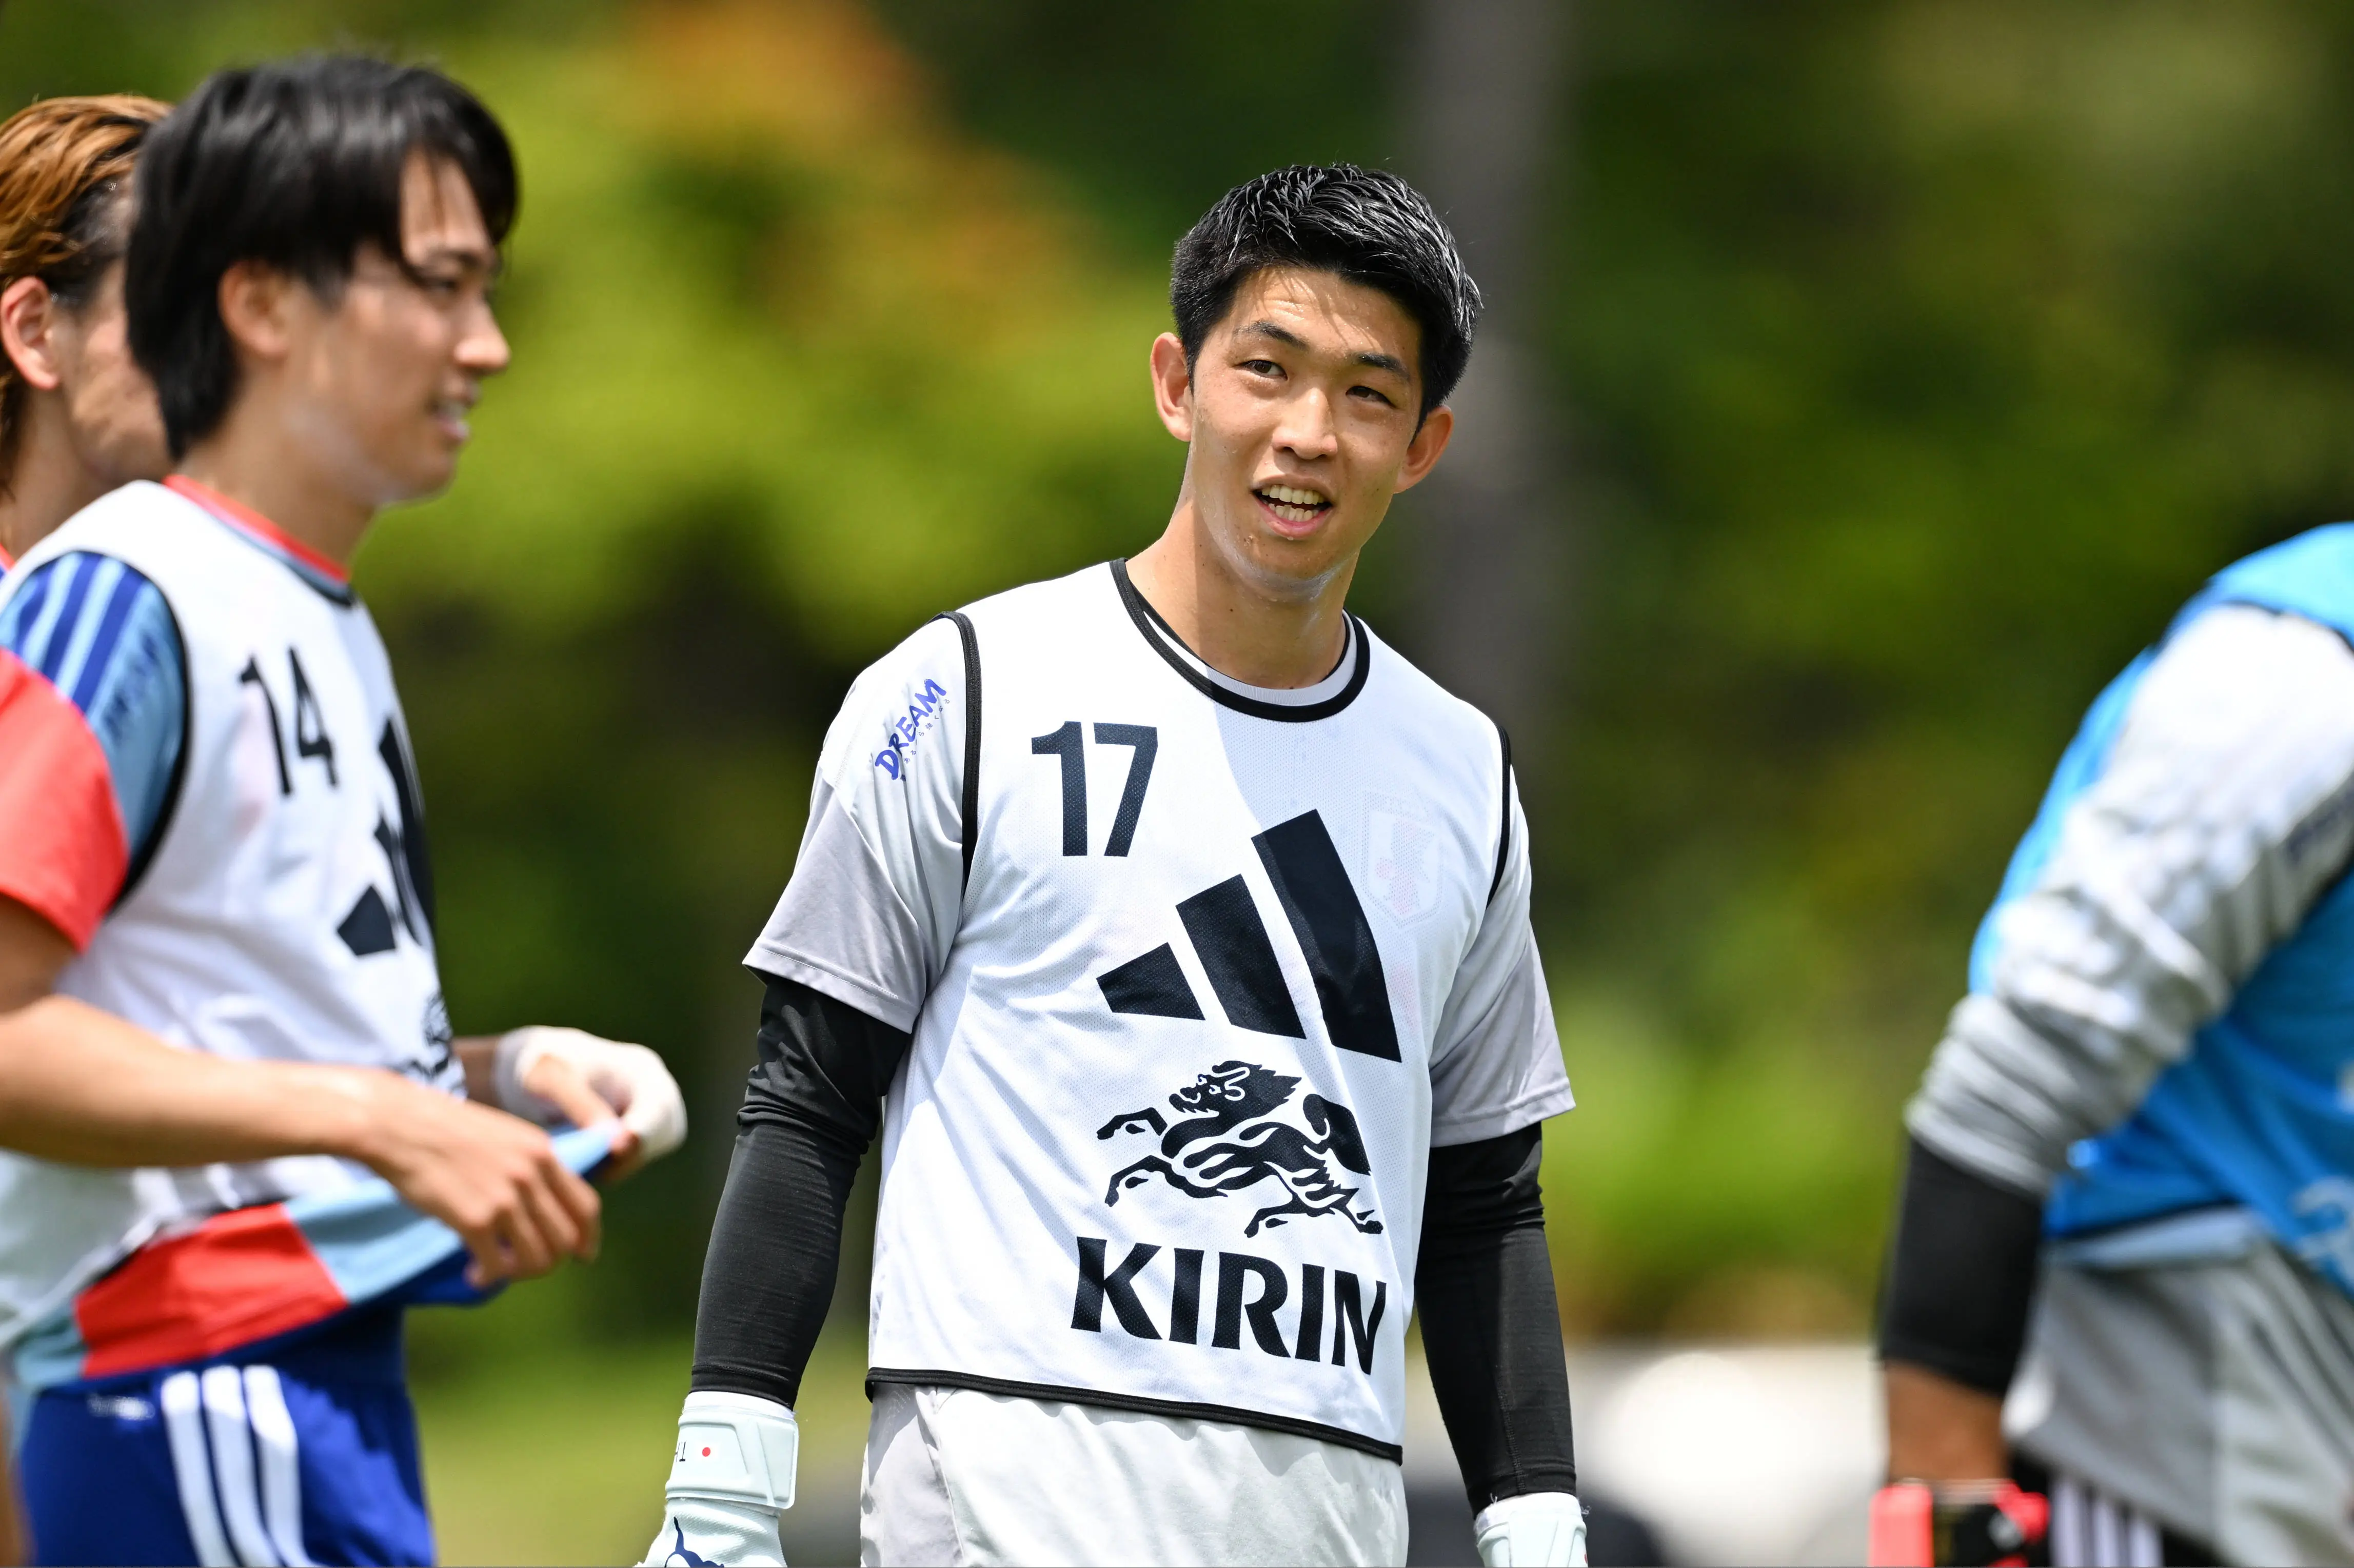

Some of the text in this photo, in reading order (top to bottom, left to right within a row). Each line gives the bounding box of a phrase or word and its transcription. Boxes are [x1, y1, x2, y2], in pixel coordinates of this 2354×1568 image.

[239, 644, 338, 797] 14
[875, 679, 947, 780] DREAM
[1031, 721, 1158, 857] 17
[1070, 1236, 1387, 1376] KIRIN
